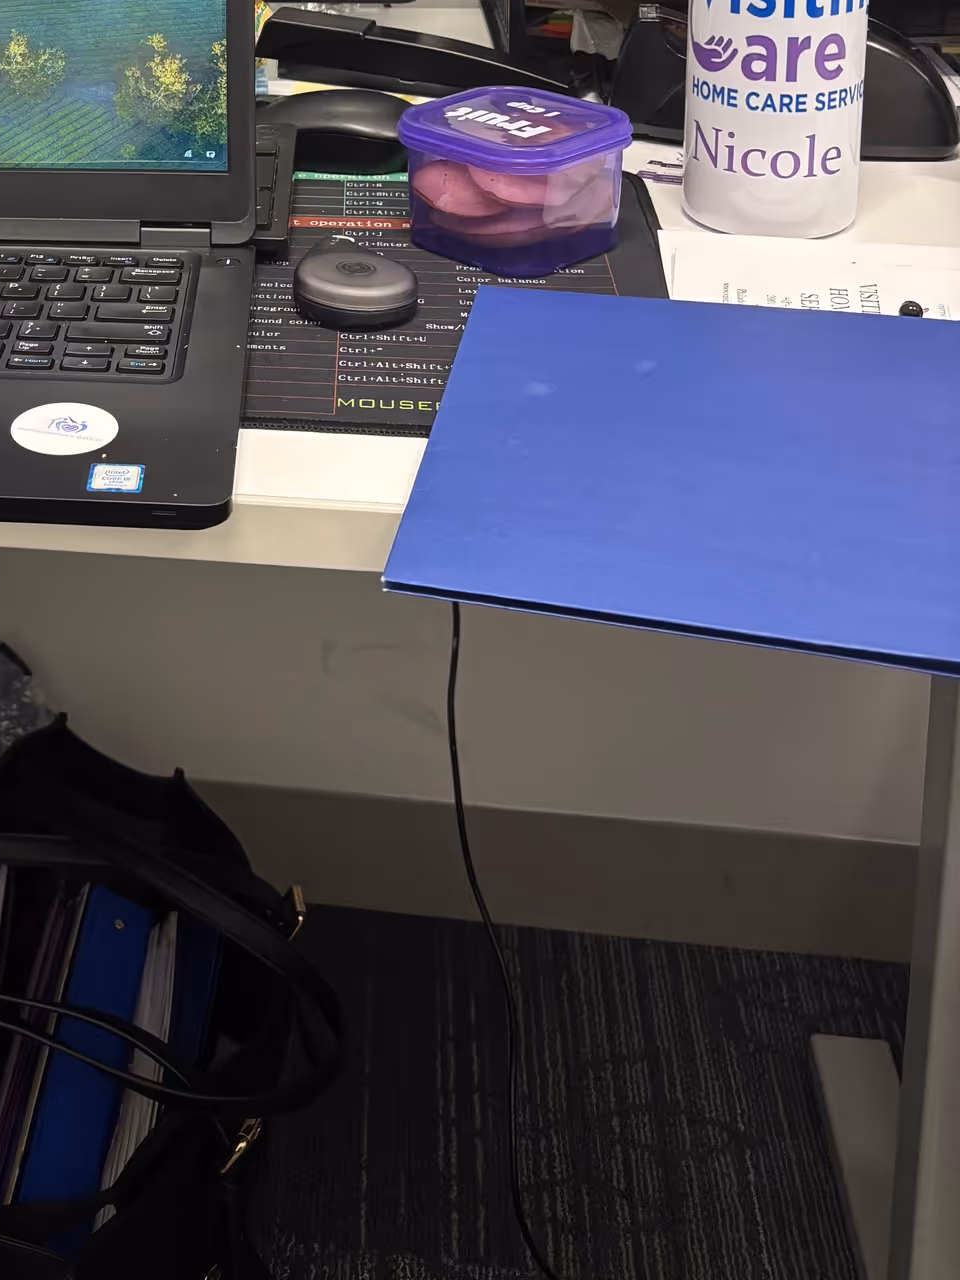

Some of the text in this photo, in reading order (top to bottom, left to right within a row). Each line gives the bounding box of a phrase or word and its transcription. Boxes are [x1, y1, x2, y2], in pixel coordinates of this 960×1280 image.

[691, 74, 739, 109] HOME
[745, 90, 808, 114] CARE
[506, 101, 546, 115] Cup
[444, 106, 553, 139] Fruit
[691, 118, 842, 180] Nicole
[308, 219, 393, 229] operation
[456, 275, 547, 286] Color balance
